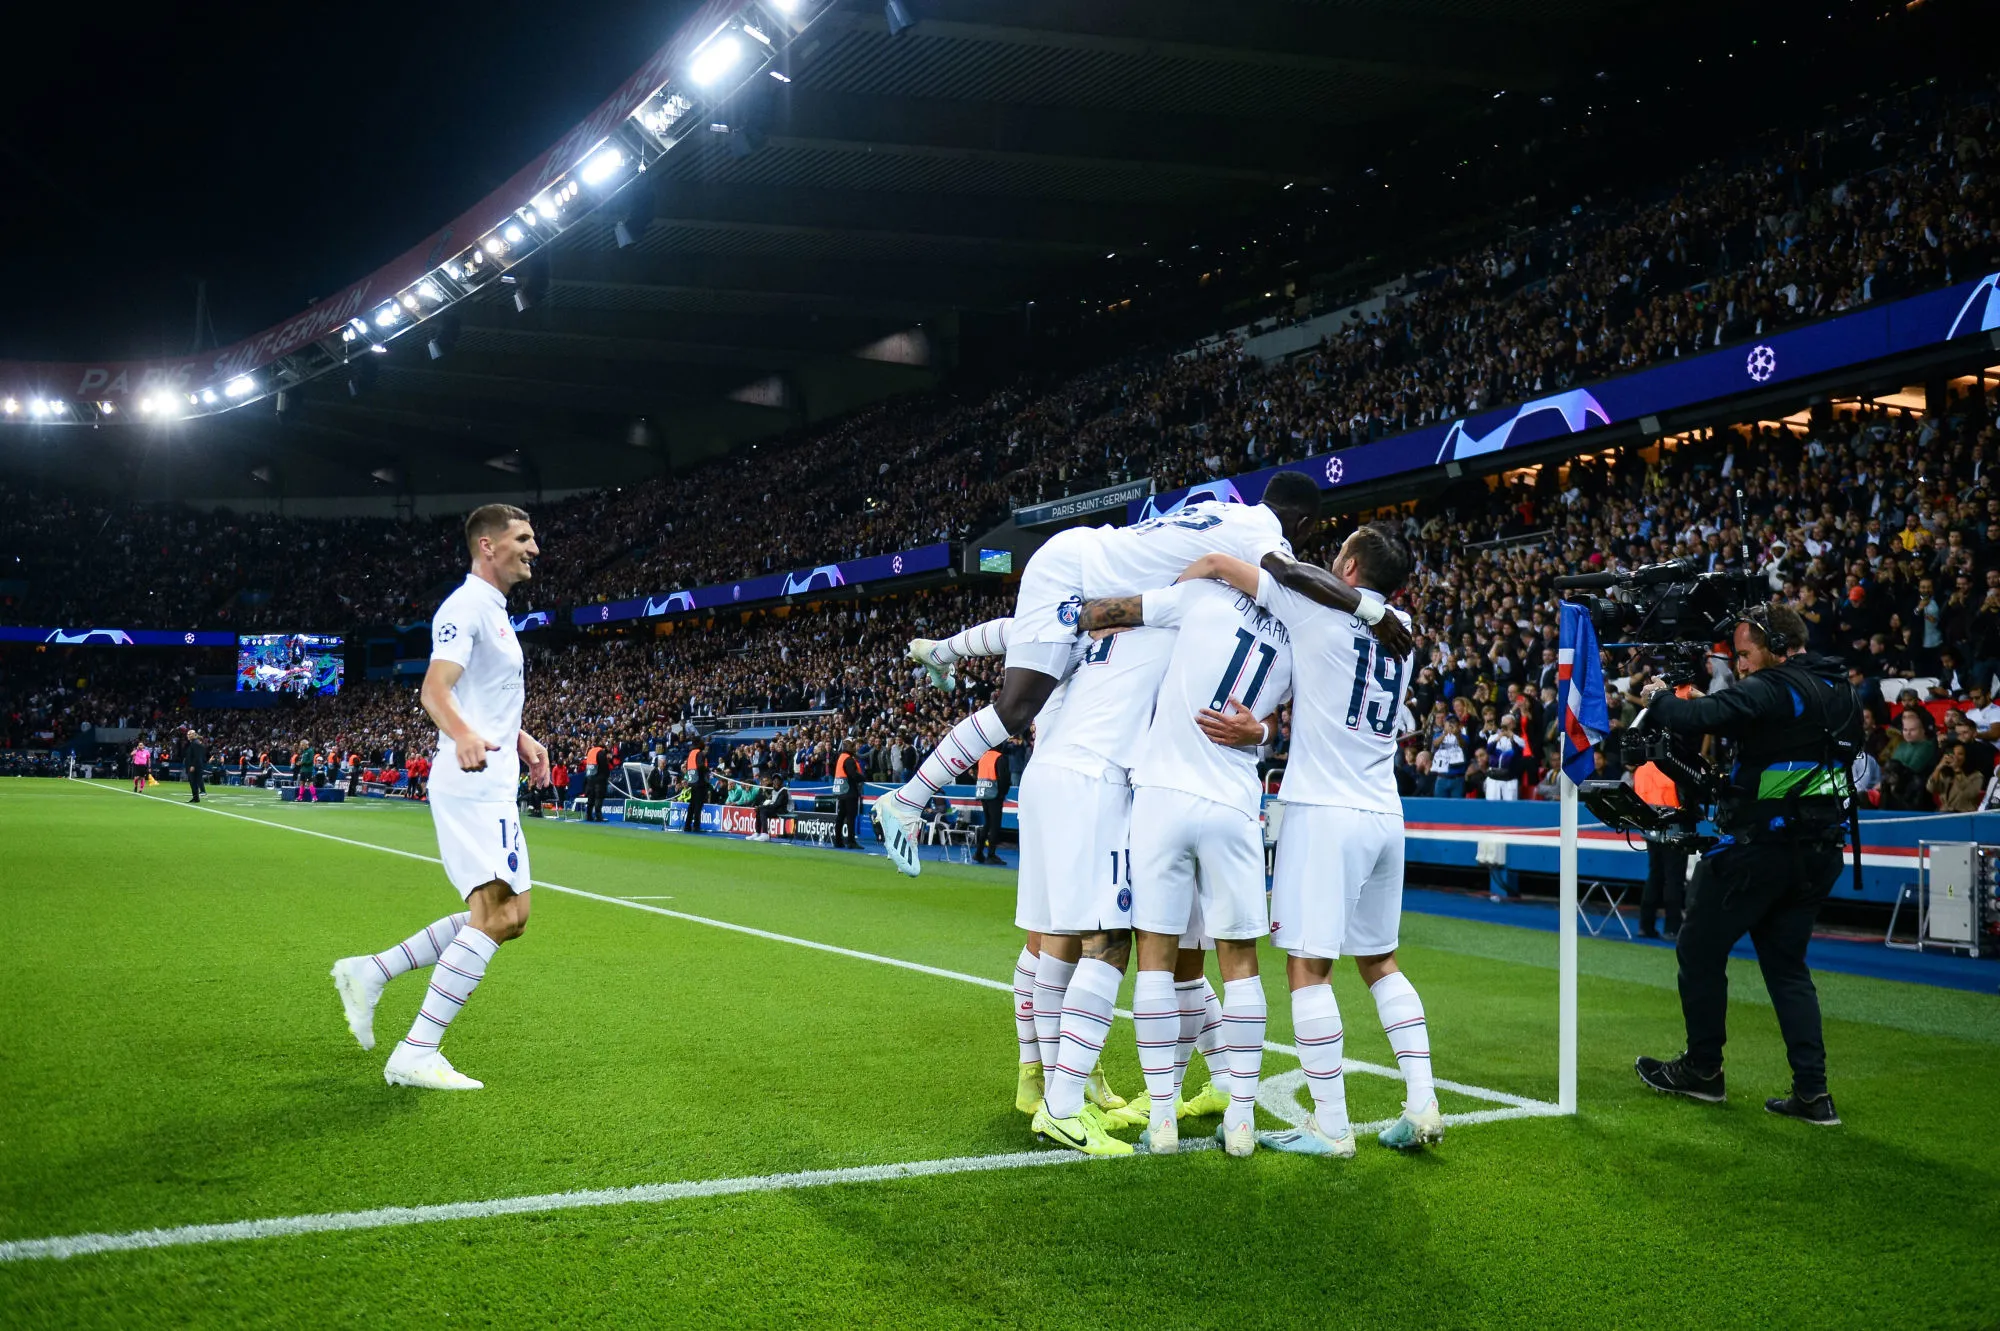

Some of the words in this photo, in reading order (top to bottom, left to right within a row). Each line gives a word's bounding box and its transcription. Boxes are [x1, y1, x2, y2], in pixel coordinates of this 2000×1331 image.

[206, 280, 370, 381] SAINT-GERMAIN
[1052, 503, 1075, 517] PARIS
[1076, 488, 1141, 512] SAINT-GERMAIN
[1234, 594, 1253, 616] DI
[1209, 626, 1278, 713] 11
[1345, 637, 1404, 737] 19
[632, 806, 644, 819] Enjoy
[499, 818, 519, 851] 12
